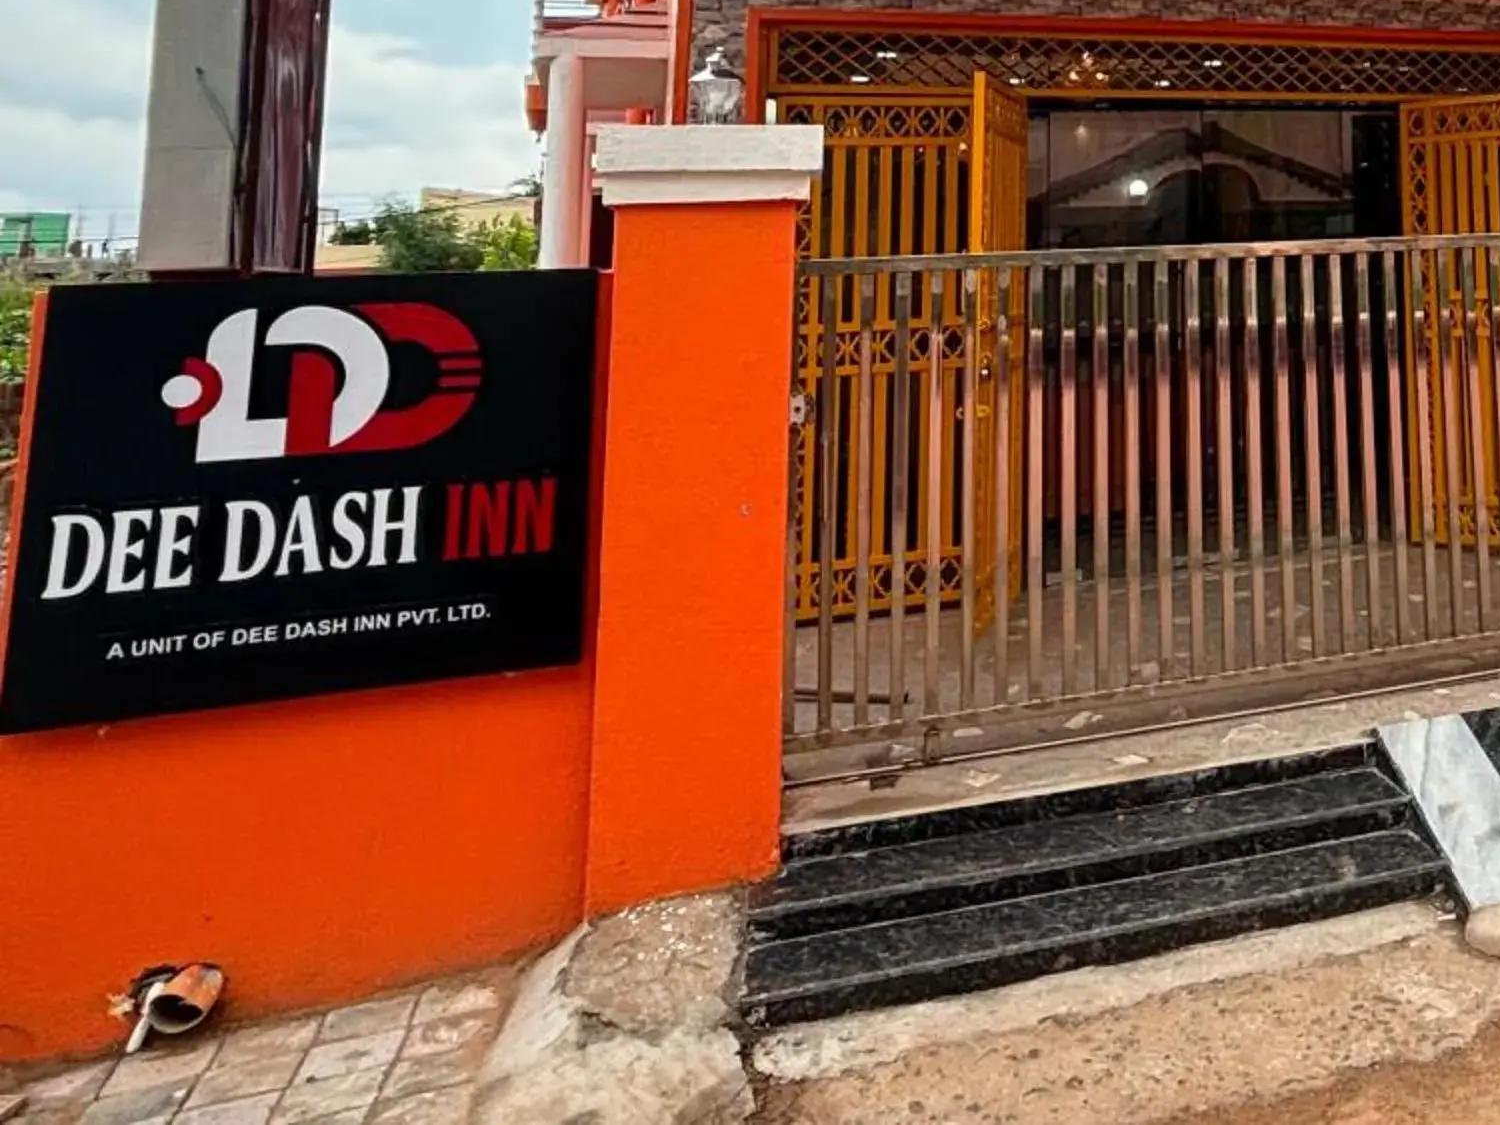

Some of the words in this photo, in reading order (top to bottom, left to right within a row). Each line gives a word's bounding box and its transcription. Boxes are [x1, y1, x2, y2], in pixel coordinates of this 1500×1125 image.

[40, 505, 200, 600] DEE
[217, 485, 424, 583] DASH
[442, 478, 556, 560] INN
[105, 642, 125, 660] A
[131, 634, 188, 657] UNIT
[193, 630, 226, 648] OF
[231, 625, 279, 646] DEE
[284, 618, 348, 641] DASH
[353, 613, 391, 632] INN
[397, 608, 441, 628] PVT.
[447, 602, 492, 622] LTD.
